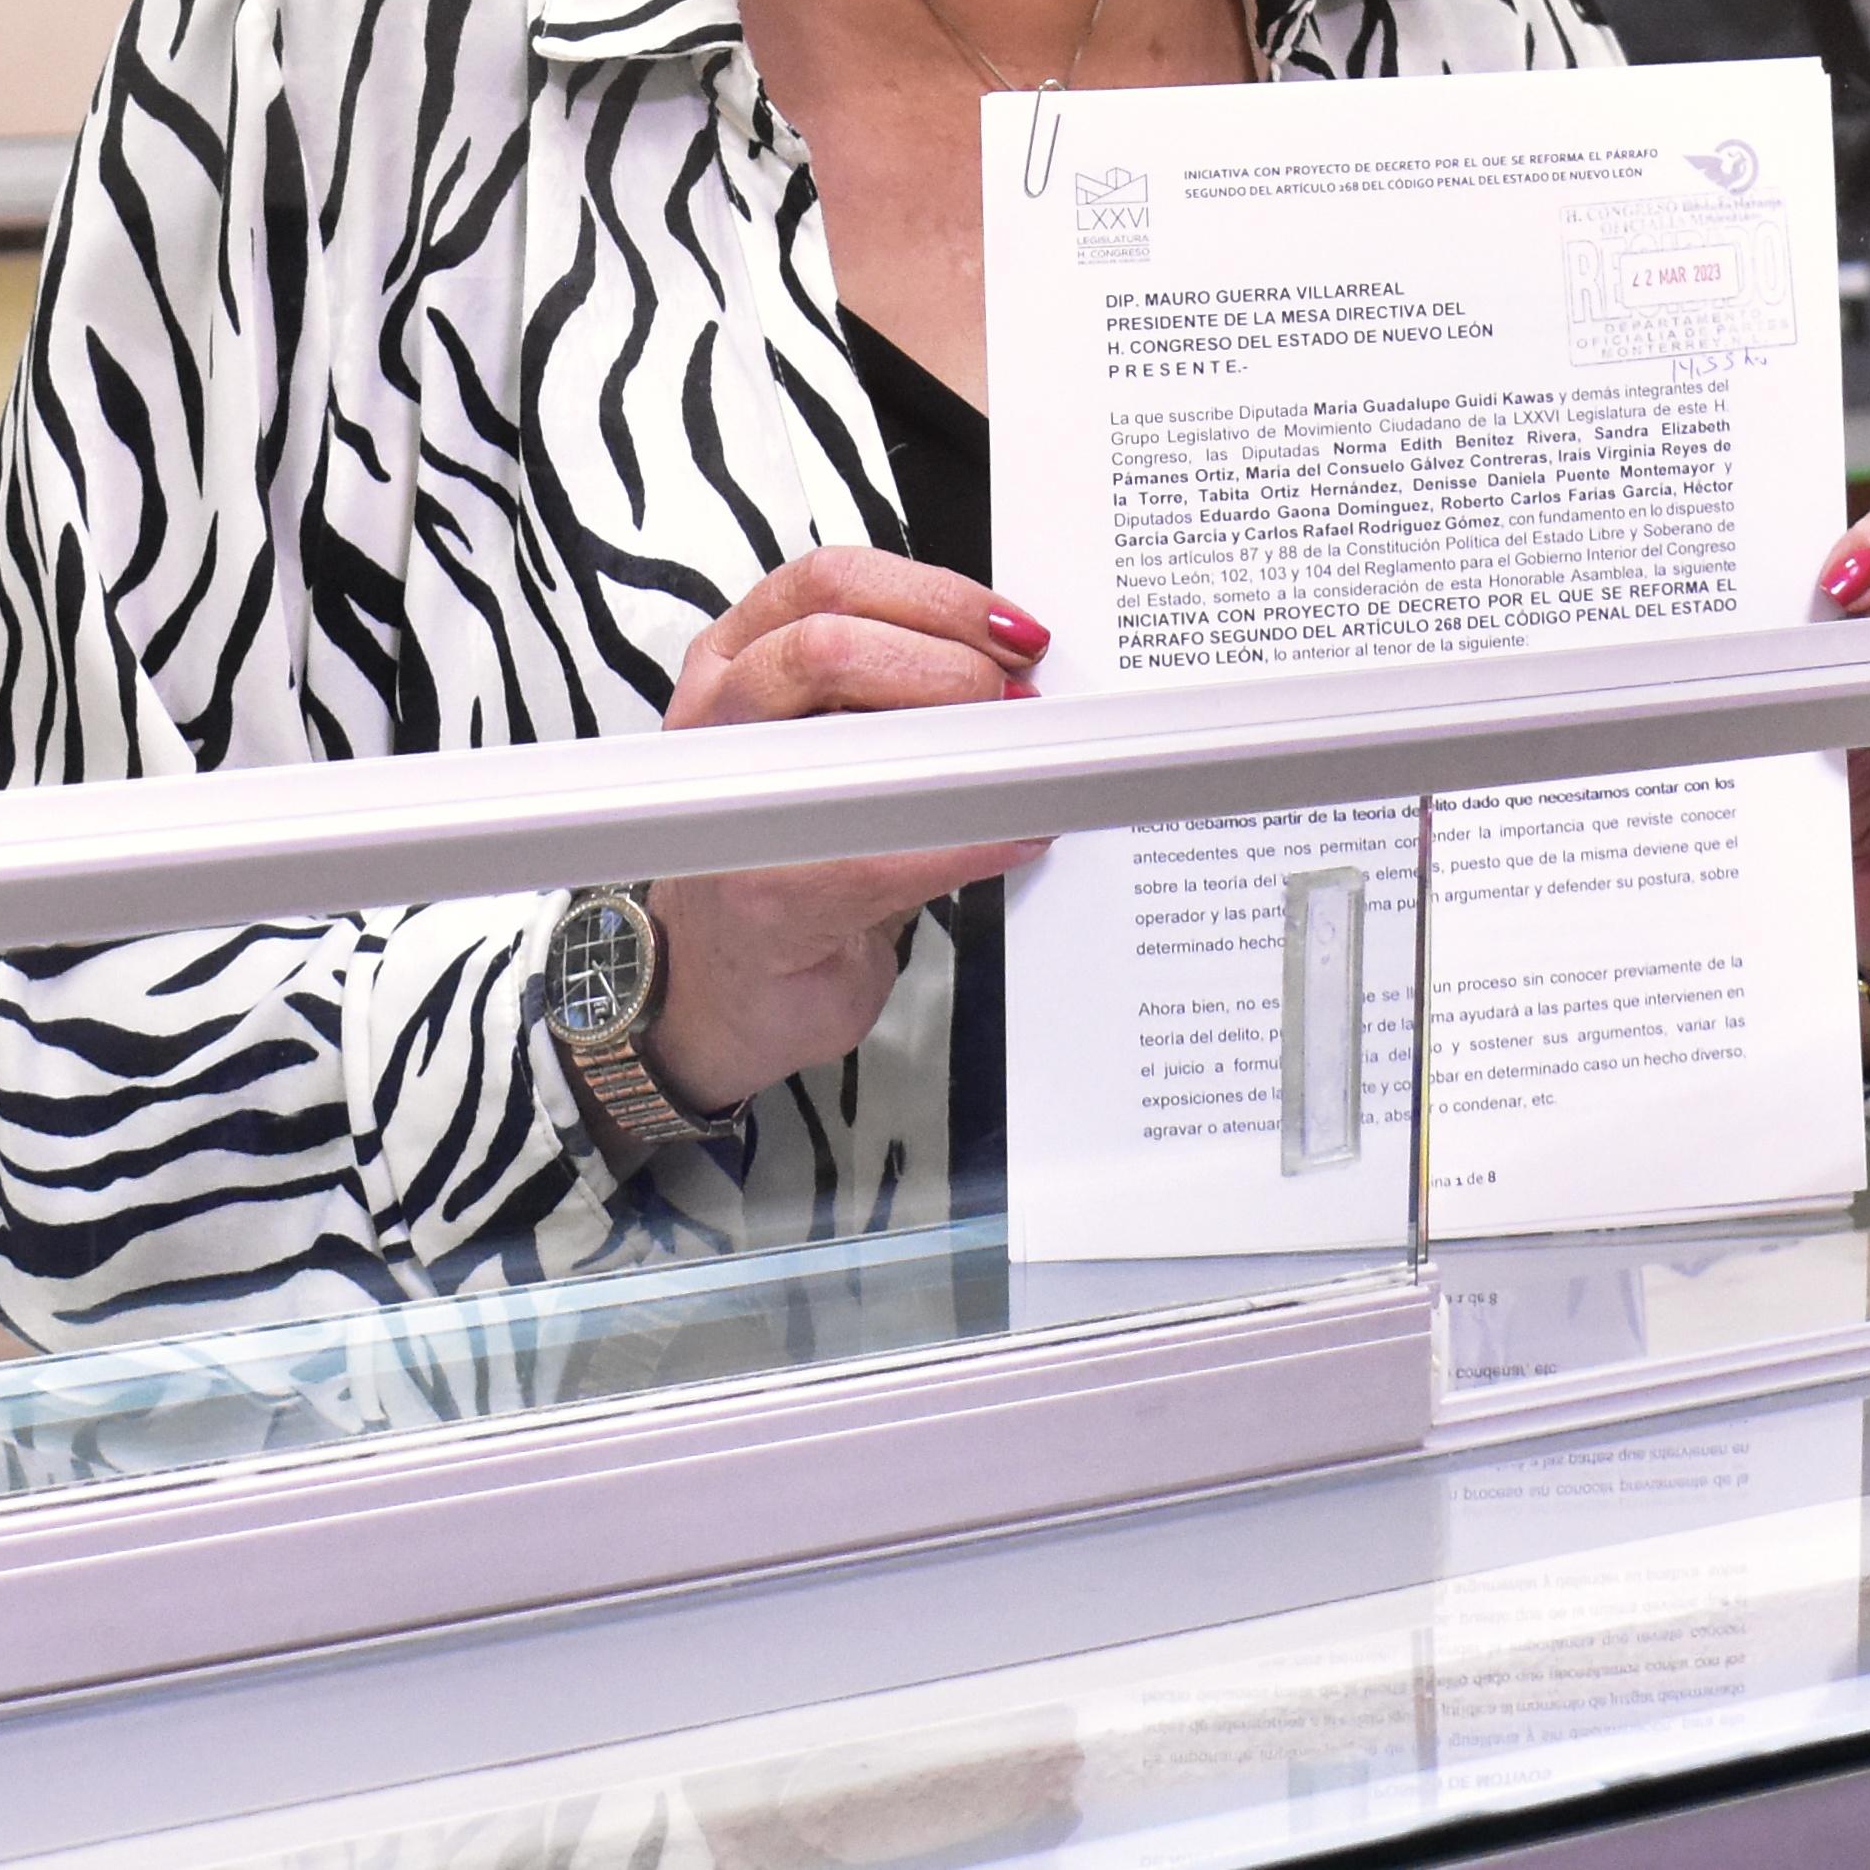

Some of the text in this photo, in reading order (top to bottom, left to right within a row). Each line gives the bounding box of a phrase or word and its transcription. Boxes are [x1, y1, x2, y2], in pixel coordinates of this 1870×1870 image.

[1183, 148, 1658, 180] INICIATIVA CON PROYECTO DE DECRETO POR EL QUE SE REFORMA EL PÁRRAFO
[1184, 166, 1642, 199] SEGUNDO DEL ARTÍCULO 268 DEL CÓDIGO PENAL DEL ESTADO DE NUEVO LEÓN
[1076, 206, 1150, 231] LXXVI
[1076, 234, 1150, 245] LEGISLATURA
[1090, 248, 1151, 259] CONGRESO
[1659, 265, 1687, 286] MAR
[1693, 262, 1722, 283] 2023
[1105, 281, 1405, 308] DIP. MAURO GUERRA VILLARREAL
[1106, 301, 1465, 332] PRESIDENTE DE LA MESA DIRECTIVA DEL
[1107, 320, 1493, 355] H. CONGRESO DEL ESTADO DE NUEVO LEÓN
[1110, 411, 1129, 425] La
[1134, 412, 1163, 427] que
[1168, 406, 1233, 423] suscribe
[1239, 402, 1308, 422] Diputada
[1362, 396, 1450, 413] Guadalupe
[1454, 392, 1497, 408] Guidi
[1502, 391, 1554, 406] Kawas
[1558, 392, 1567, 406] y
[1571, 385, 1620, 401] demás
[1624, 381, 1703, 400] integrantes
[1707, 378, 1728, 393] del
[1110, 430, 1159, 448] Grupo
[1167, 427, 1249, 446] Legislativo
[1256, 425, 1276, 439] de
[1283, 420, 1372, 438] Movimiento
[1378, 416, 1461, 433] Ciudadano
[1467, 413, 1487, 428] de
[1493, 412, 1506, 426] la
[1513, 408, 1559, 425] LXXVI
[1567, 405, 1646, 424] Legislatura
[1652, 402, 1671, 417] de
[1677, 401, 1707, 415] este
[1206, 447, 1228, 462] las
[1242, 443, 1319, 462] Diputadas
[1333, 441, 1386, 455] Norma
[1400, 436, 1442, 452] Edith
[1594, 424, 1648, 440] Sandra
[1661, 418, 1730, 436] Elizabeth
[1113, 492, 1127, 507] la
[1197, 486, 1249, 503] Tabita
[1260, 484, 1299, 499] Ortiz
[1413, 476, 1477, 491] Denisse
[1487, 470, 1545, 487] Daniela
[1556, 467, 1610, 483] Puente
[1620, 462, 1715, 479] Montemayor
[1724, 461, 1732, 475] y
[1117, 578, 1737, 629] INICIATIVA CON PROYECTO DE DECRETO POR EL QUE SE REFORMA EL
[1118, 597, 1737, 649] PÁRRAFO SEGUNDO DEL ARTÍCULO 268 DEL CÓDIGO PENAL DEL ESTADO
[1119, 654, 1143, 669] DE
[1148, 651, 1210, 668] NUEVO
[1273, 647, 1287, 661] lo
[1292, 644, 1350, 660] anterior
[1354, 641, 1368, 657] al
[1373, 642, 1412, 656] tenor
[1416, 638, 1435, 653] de
[1440, 637, 1453, 652] la
[1461, 777, 1735, 810] dado que necesitamos contar con los
[1132, 808, 1736, 866] antecedentes que nos permitan la importancia que reviste conocer
[1138, 997, 1280, 1017] Ahora bien, no es
[1466, 1171, 1484, 1186] de
[1487, 1170, 1497, 1184] 8
